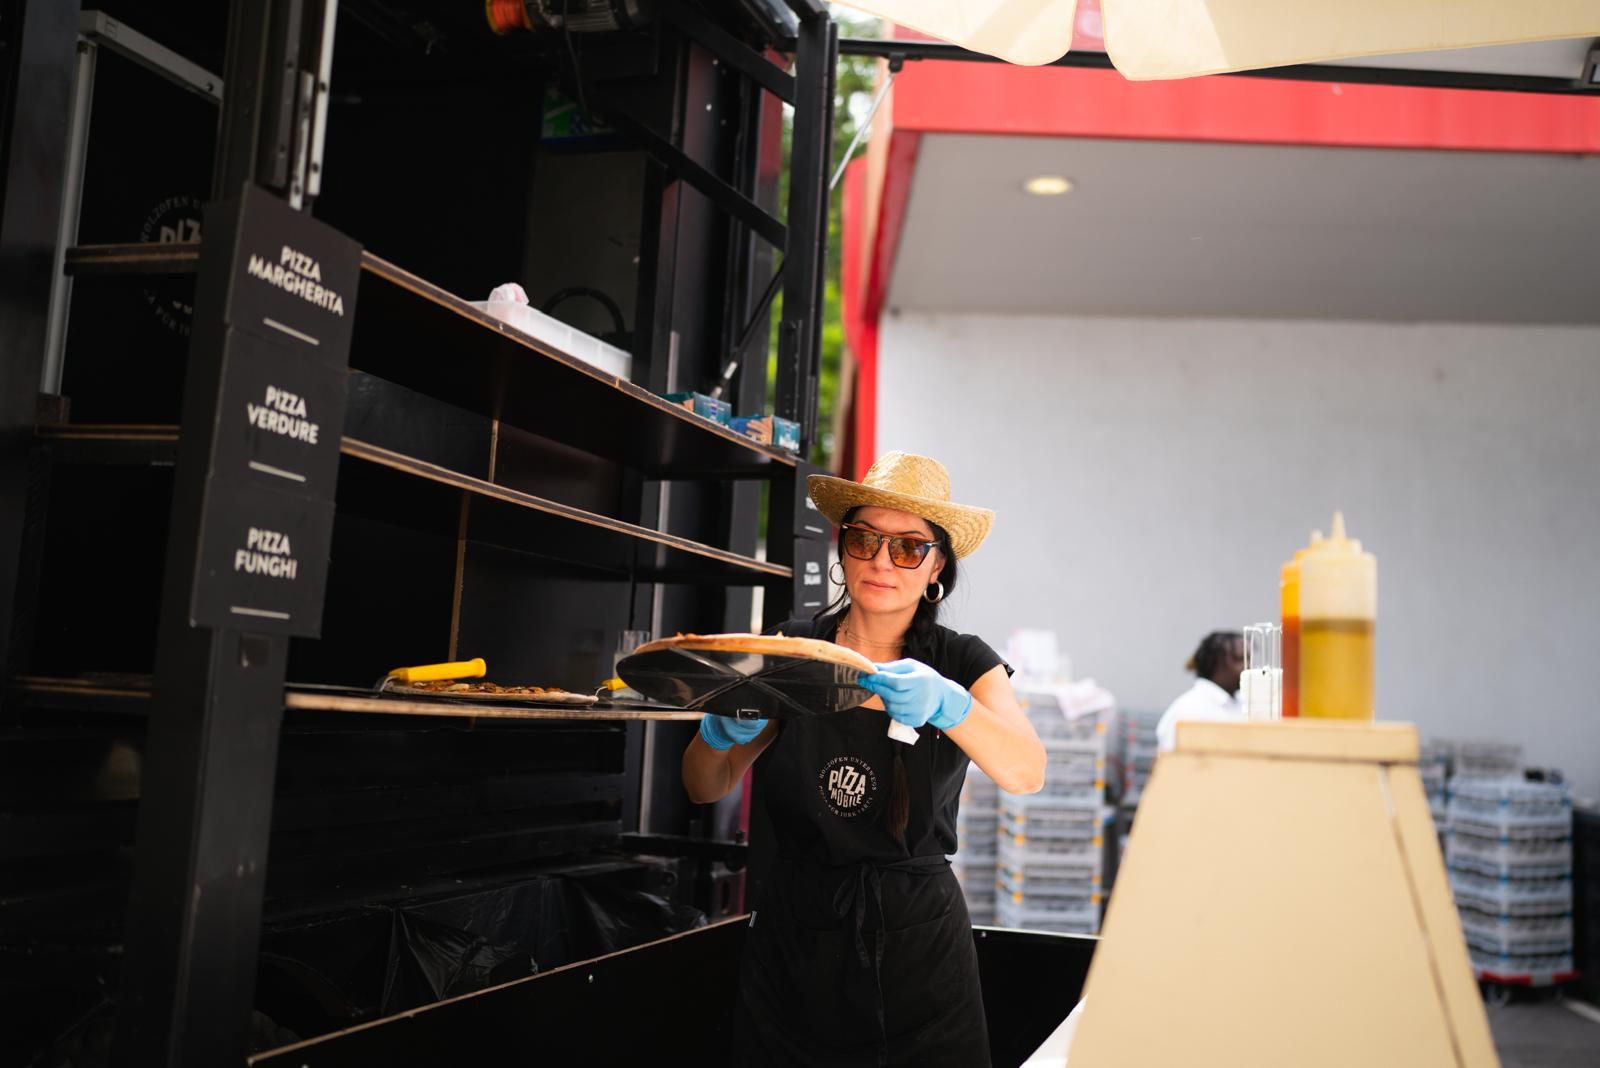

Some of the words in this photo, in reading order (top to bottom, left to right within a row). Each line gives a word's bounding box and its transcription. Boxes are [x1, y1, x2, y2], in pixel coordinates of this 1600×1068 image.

[281, 245, 321, 283] PIZZA
[247, 253, 344, 316] MARGHERITA
[265, 384, 307, 419] PIZZA
[247, 402, 319, 445] VERDURE
[247, 526, 291, 556] PIZZA
[234, 548, 298, 580] FUNGHI
[828, 765, 866, 795] PIZZA
[830, 787, 863, 808] MOBILE
